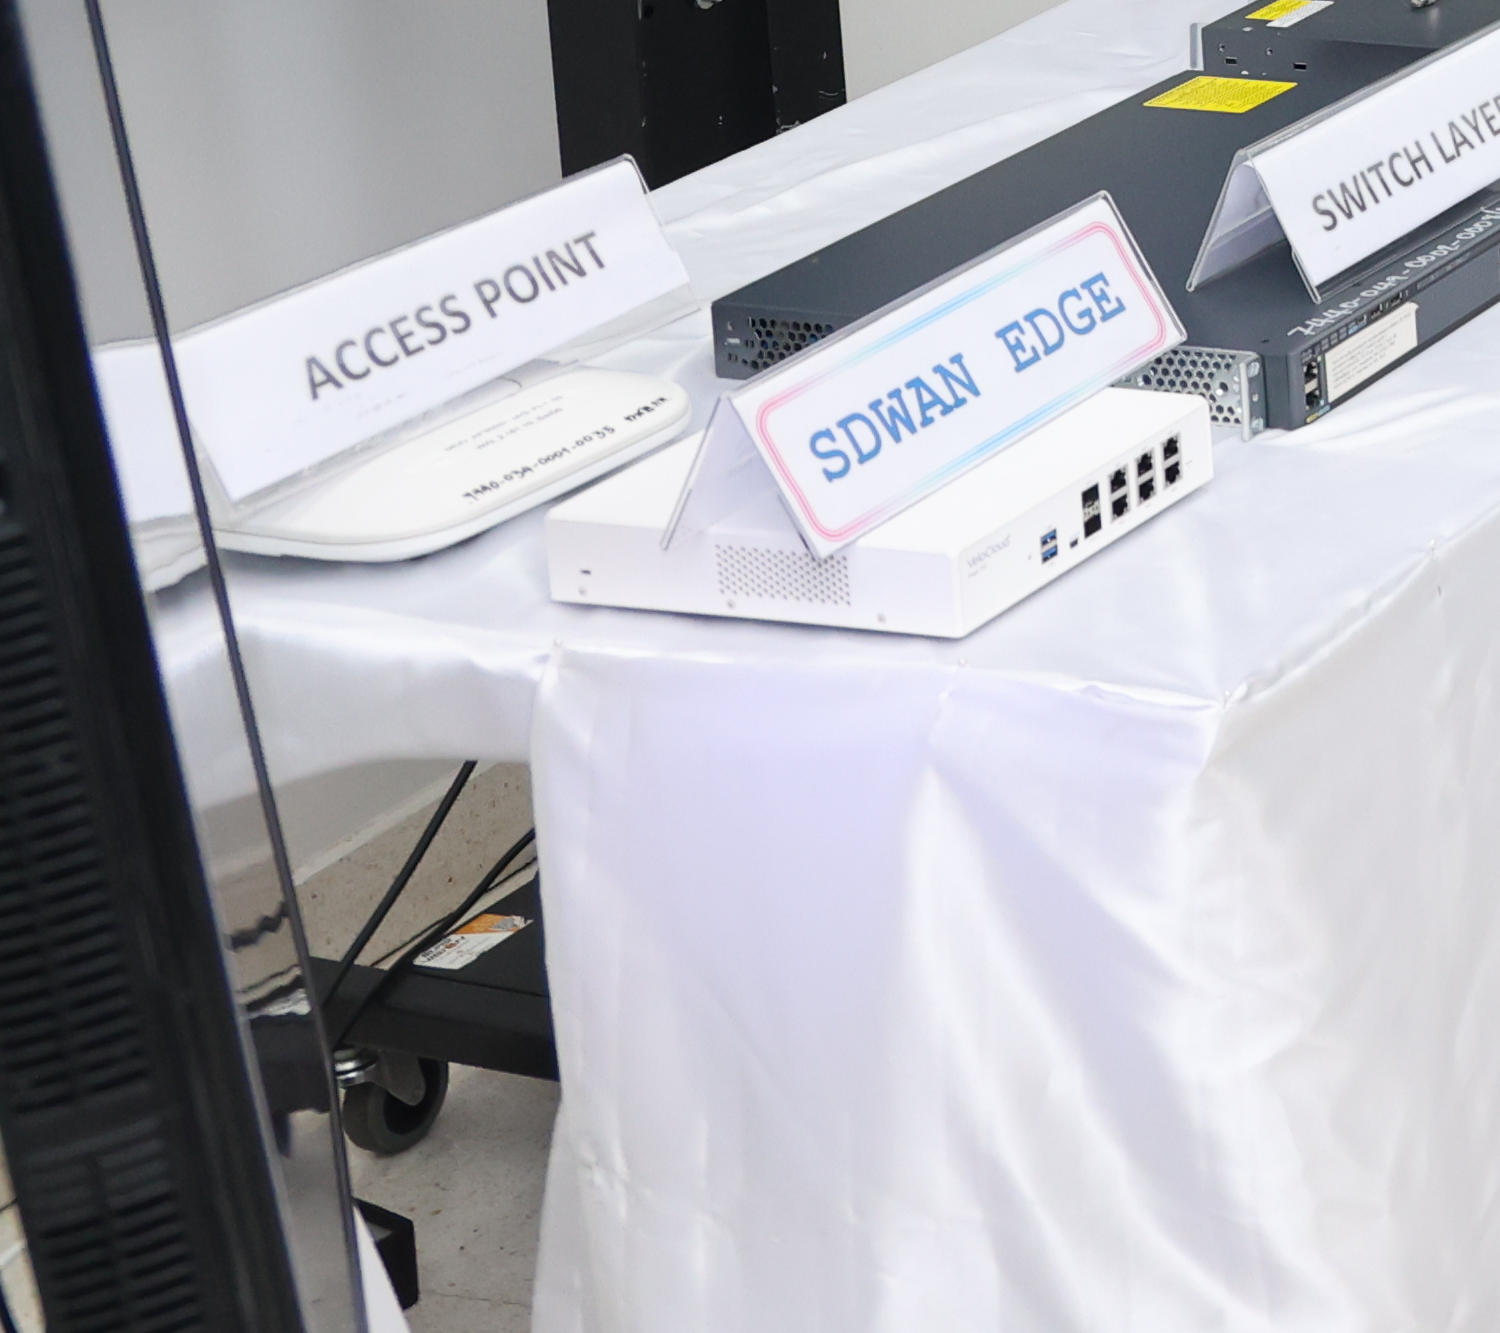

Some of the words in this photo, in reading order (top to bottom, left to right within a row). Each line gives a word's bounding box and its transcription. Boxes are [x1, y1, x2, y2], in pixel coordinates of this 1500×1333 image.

[1311, 141, 1434, 232] SWITCH
[303, 294, 472, 401] ACCESS
[473, 230, 608, 320] POINT
[808, 352, 984, 483] SDWAN
[994, 272, 1127, 373] EDGE
